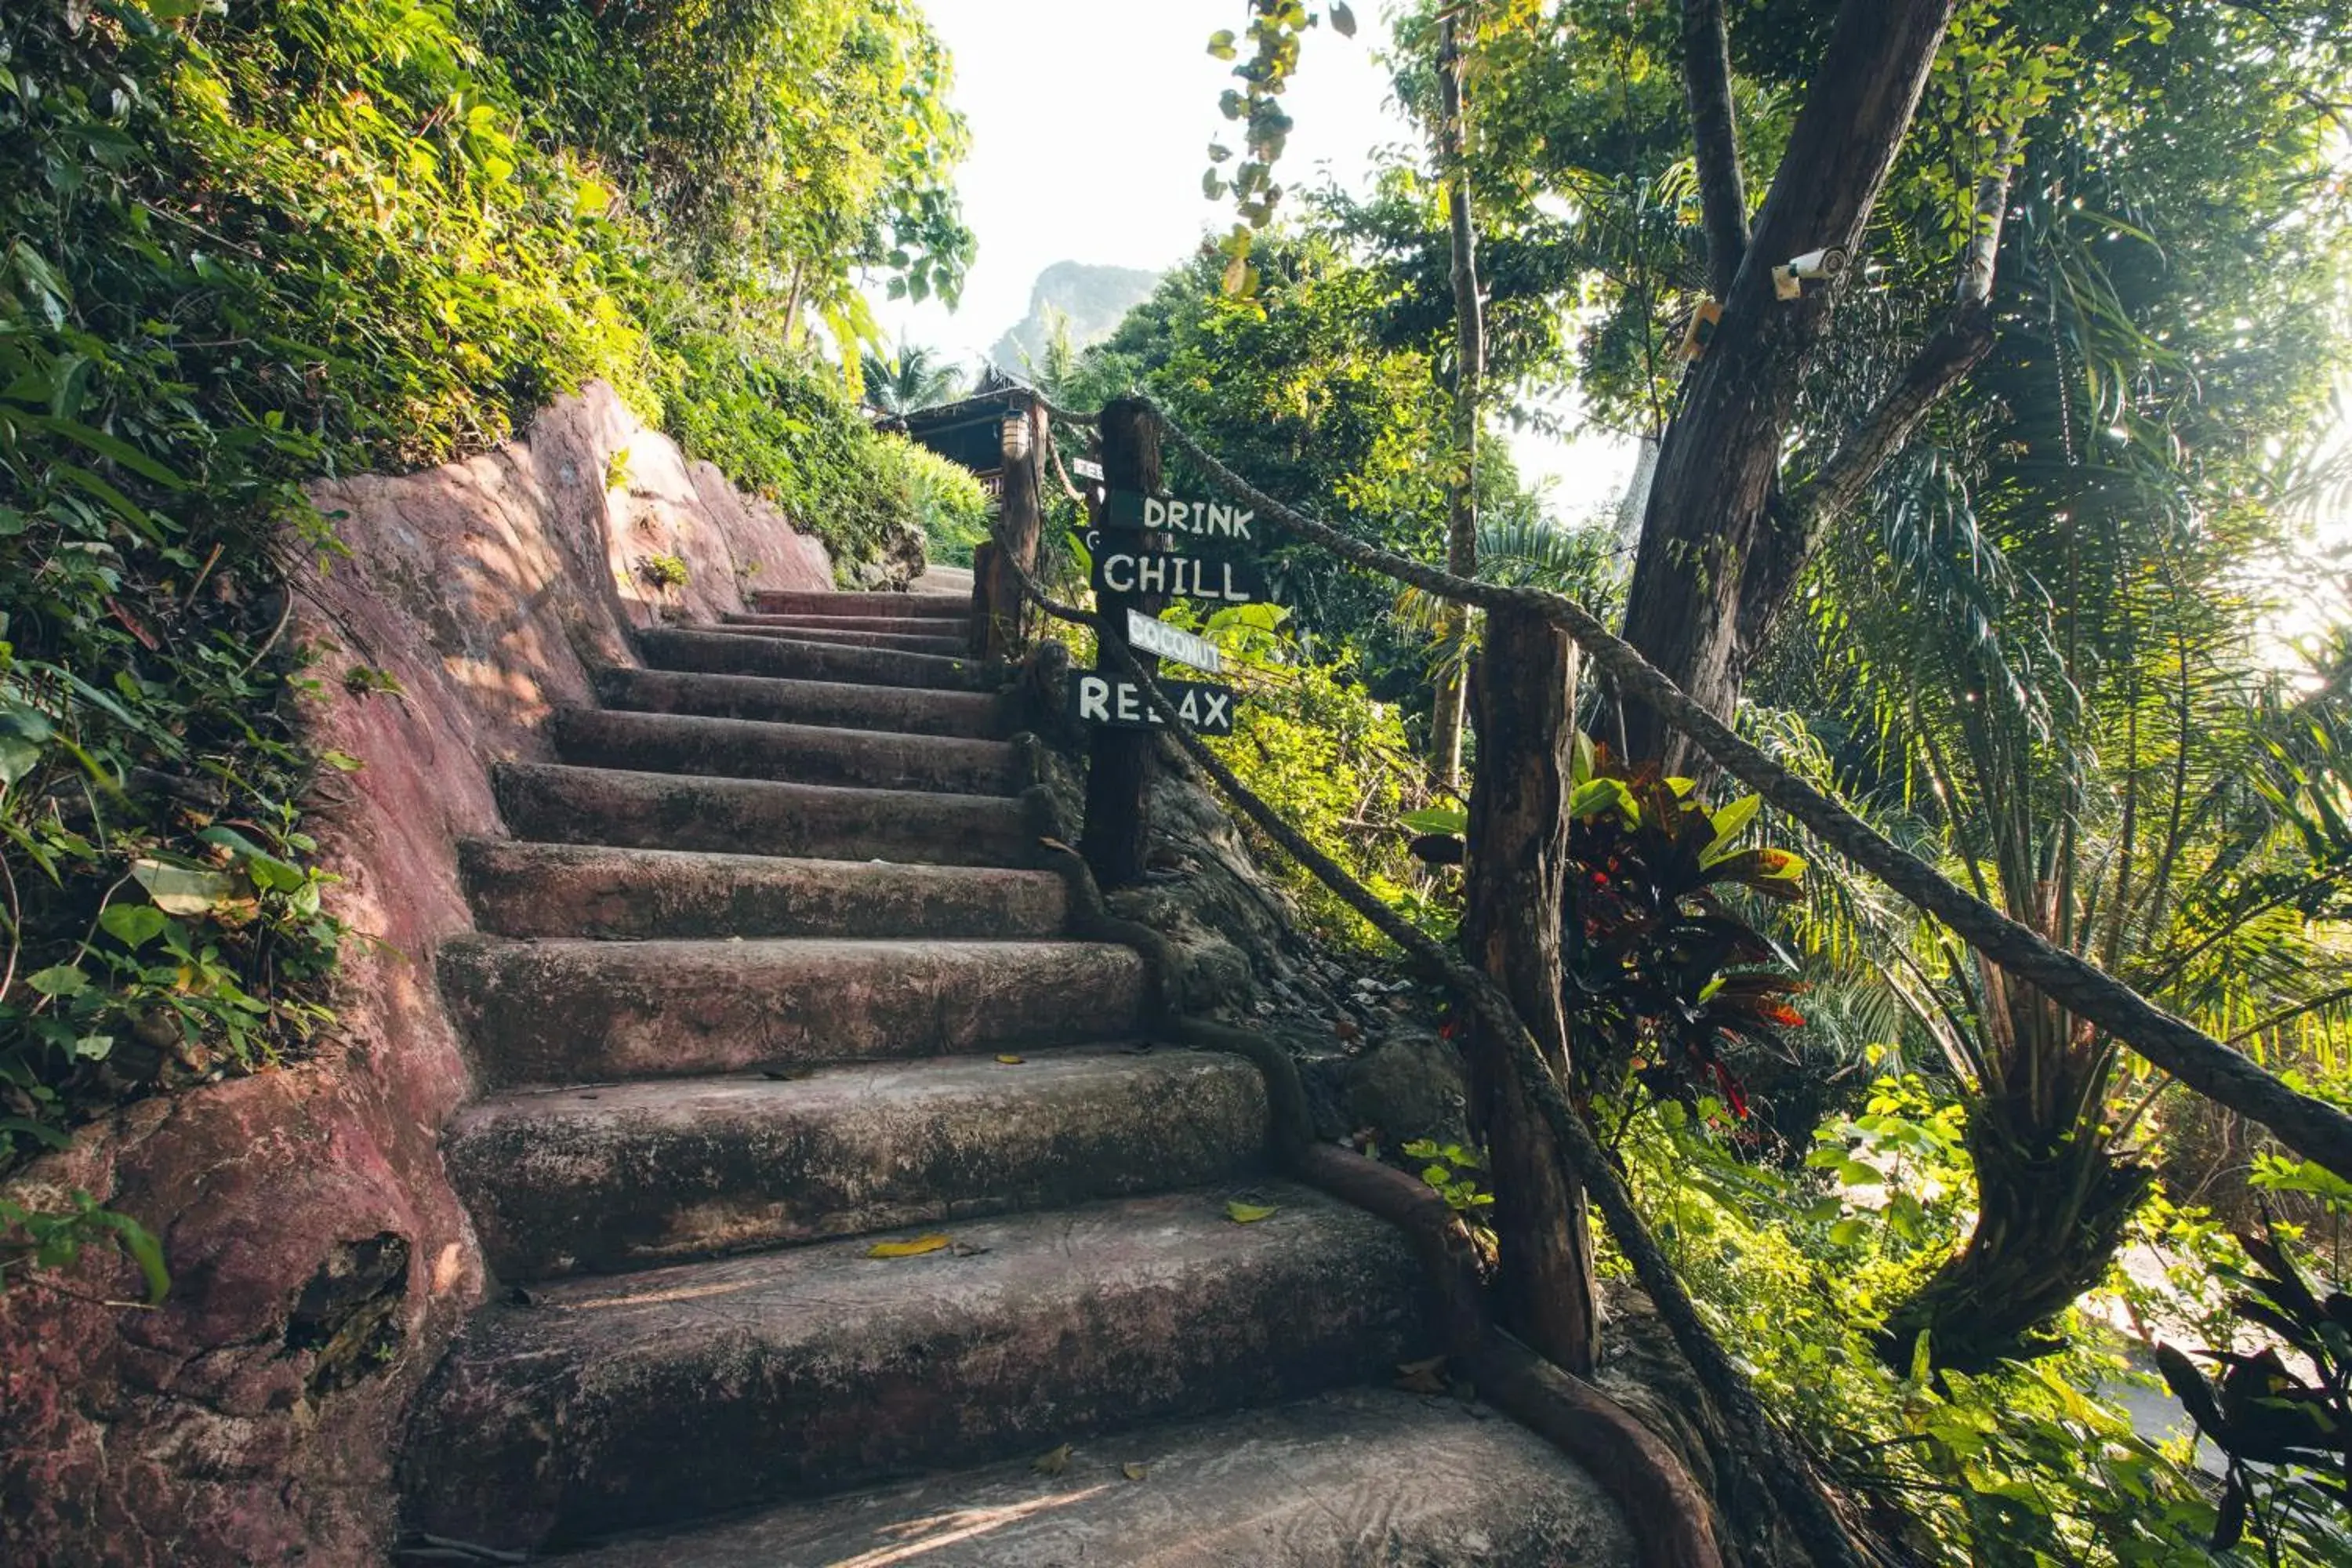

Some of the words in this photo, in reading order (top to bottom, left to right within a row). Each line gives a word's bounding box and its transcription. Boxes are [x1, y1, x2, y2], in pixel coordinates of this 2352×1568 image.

[1144, 496, 1254, 540] DRINK
[1103, 554, 1250, 601] CHILL
[1129, 614, 1218, 671] COCONUT
